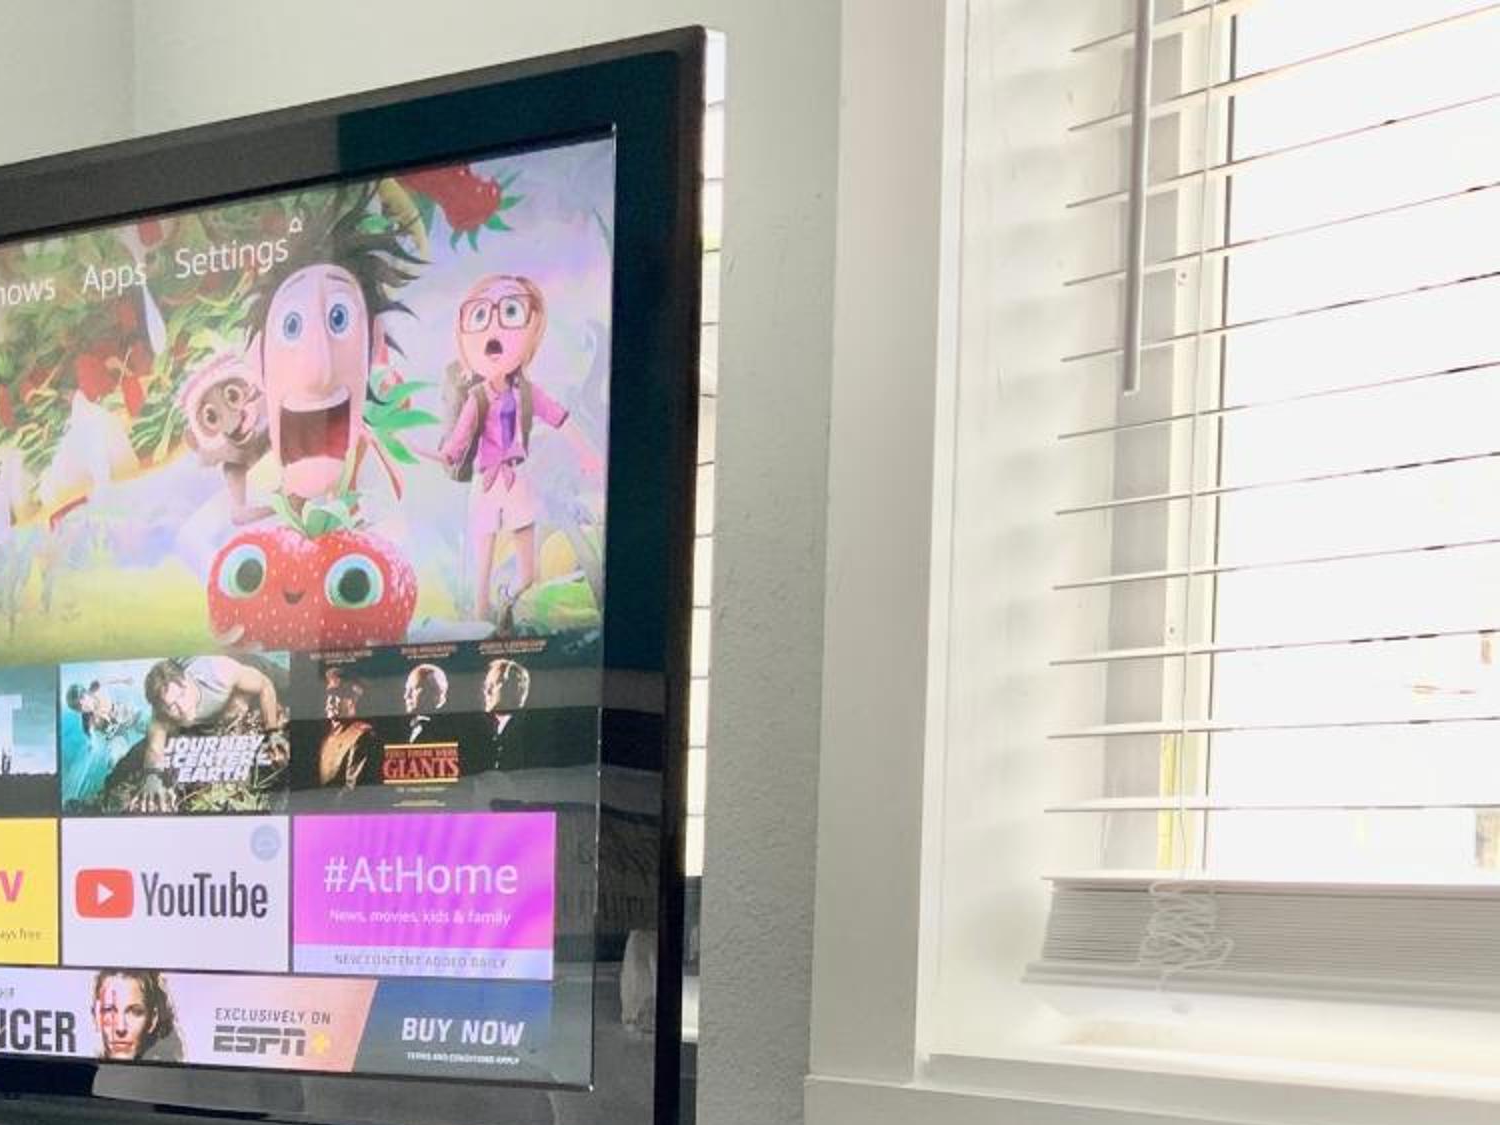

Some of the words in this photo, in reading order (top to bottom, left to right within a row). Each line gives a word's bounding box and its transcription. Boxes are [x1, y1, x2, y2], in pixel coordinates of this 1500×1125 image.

[176, 238, 289, 280] Settings
[84, 260, 147, 297] Apps
[383, 757, 459, 778] GIANTS
[323, 856, 518, 894] #AtHome
[141, 872, 268, 918] YouTube
[215, 1008, 306, 1024] EXCLUSIVELY
[311, 1011, 332, 1025] ON
[401, 1017, 453, 1042] BUY
[461, 1019, 525, 1046] NOW
